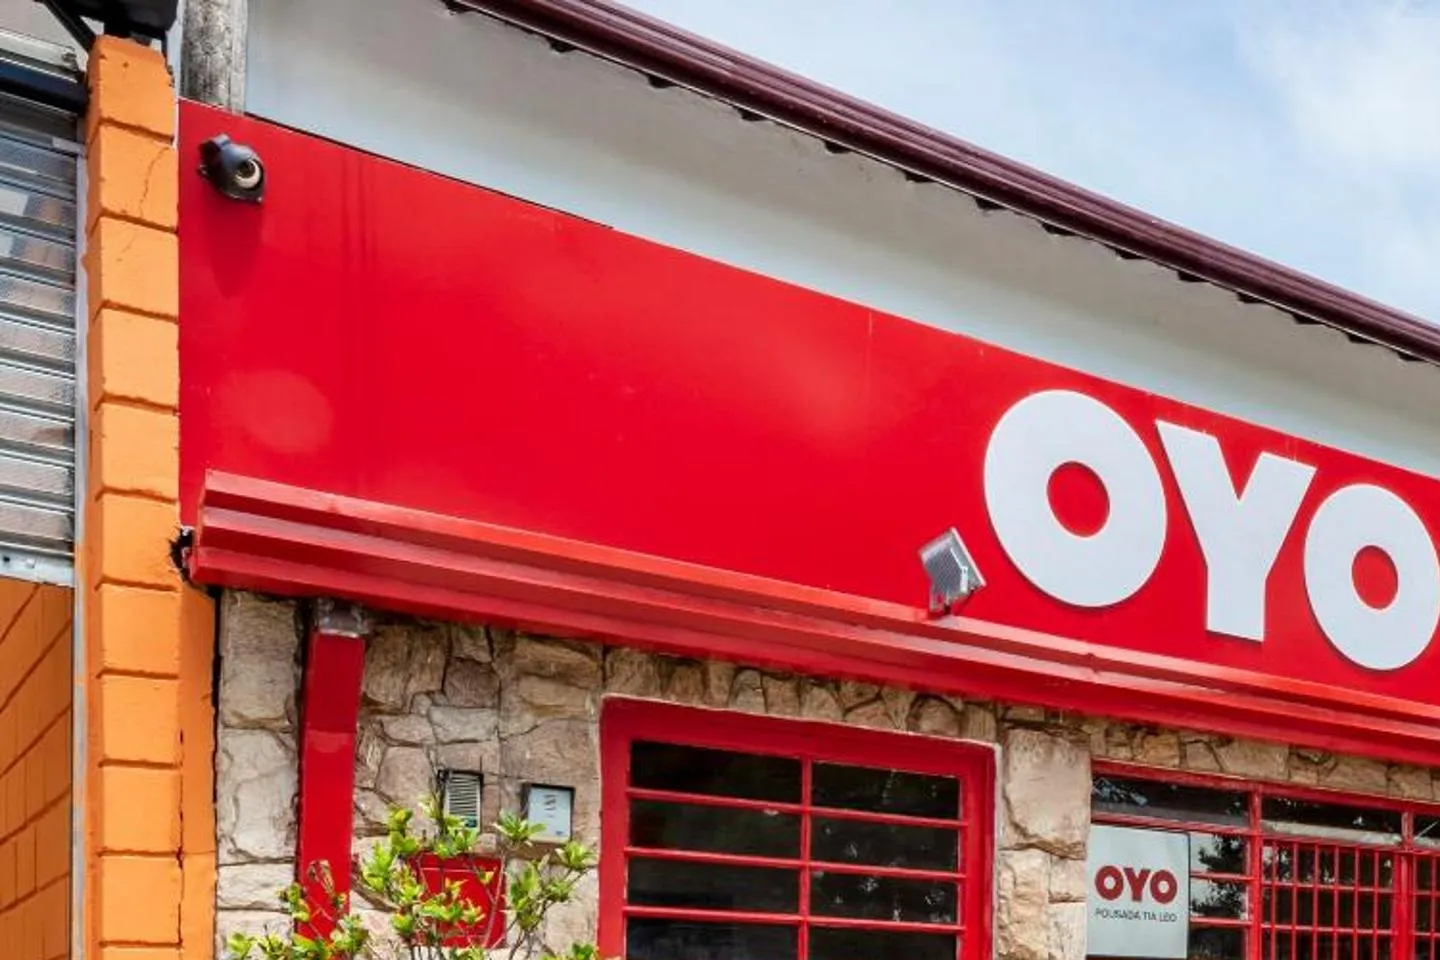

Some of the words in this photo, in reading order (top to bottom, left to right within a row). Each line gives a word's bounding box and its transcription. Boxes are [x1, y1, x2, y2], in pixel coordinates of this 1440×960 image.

[1094, 865, 1178, 904] OYO
[1095, 907, 1141, 921] POUSADA
[1143, 911, 1157, 921] TIA
